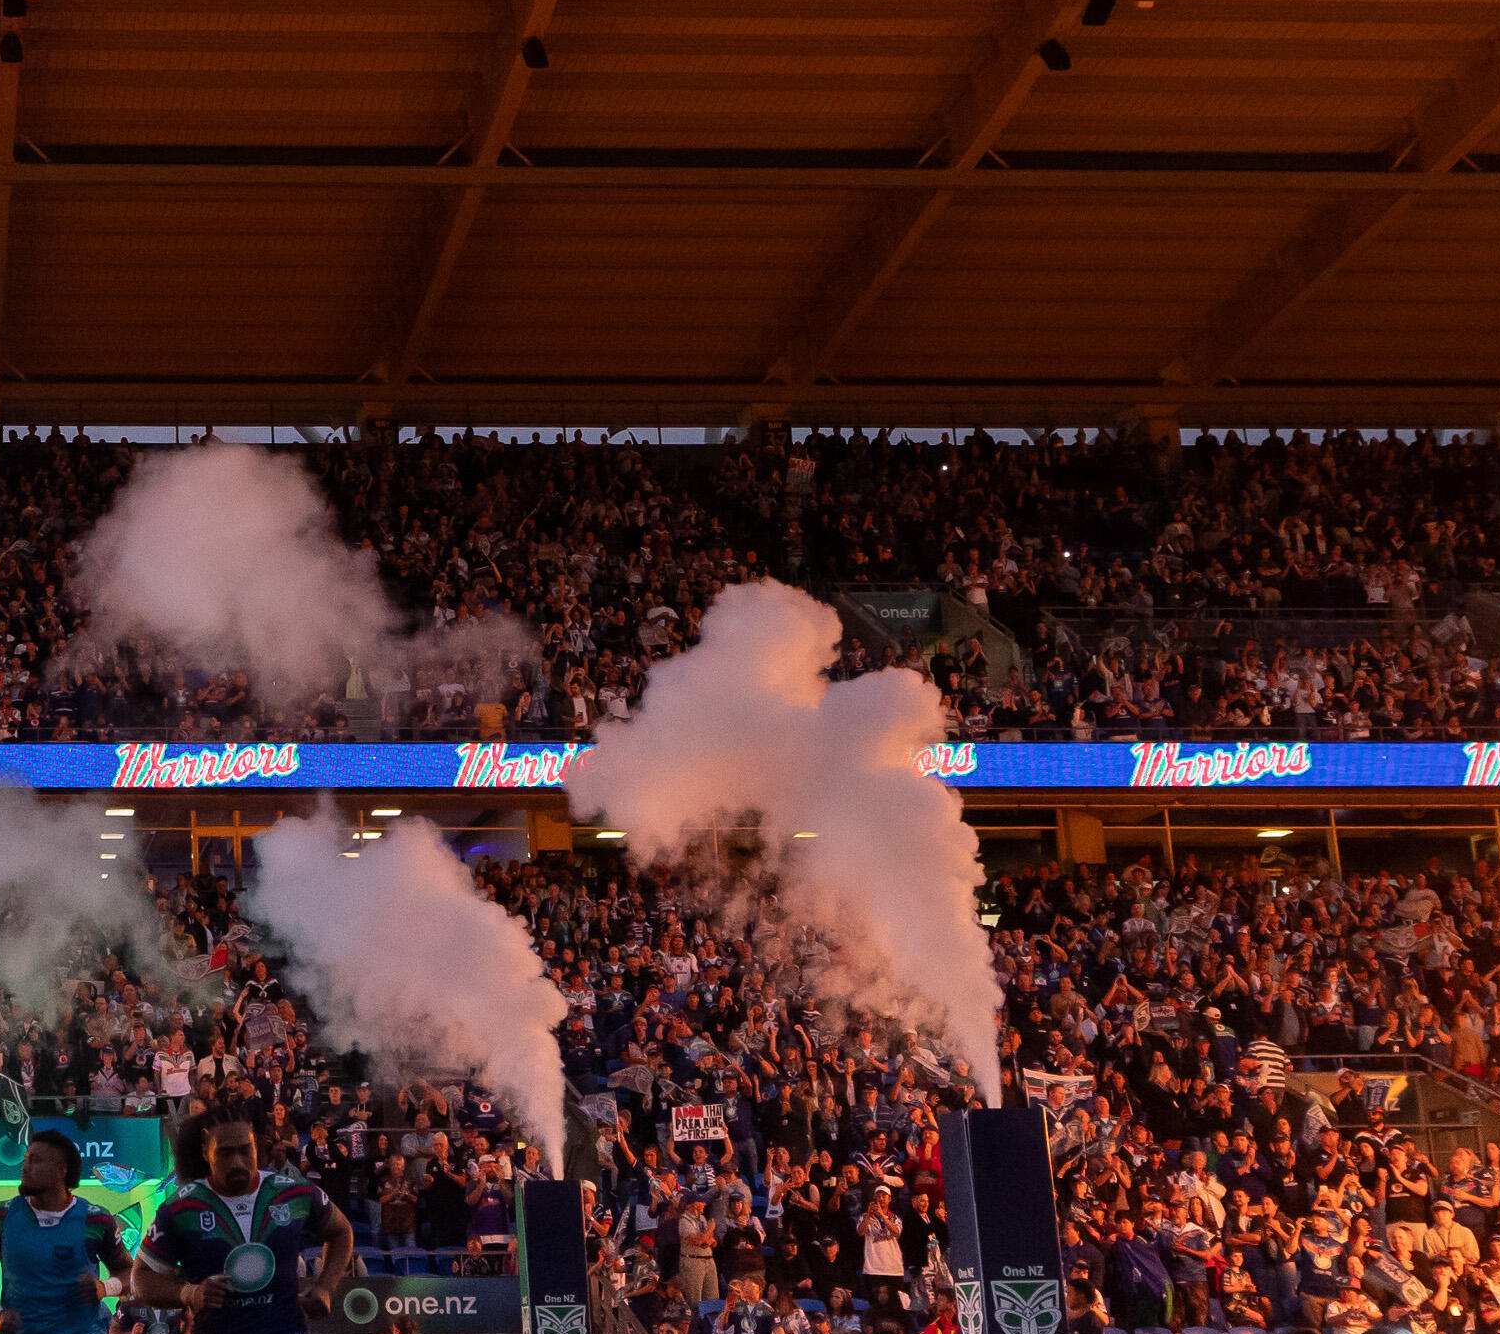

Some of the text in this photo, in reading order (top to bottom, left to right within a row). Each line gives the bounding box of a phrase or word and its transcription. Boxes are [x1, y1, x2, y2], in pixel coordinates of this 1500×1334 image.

[880, 607, 929, 619] one.nz
[112, 743, 299, 788] Warriors
[1130, 742, 1311, 787] Warriors
[705, 1105, 722, 1117] THAT
[676, 1117, 701, 1129] PREM
[688, 1128, 709, 1139] FIRST
[1002, 1266, 1045, 1277] One NZ
[544, 1294, 575, 1304] One NZ
[385, 1296, 477, 1315] one.nz
